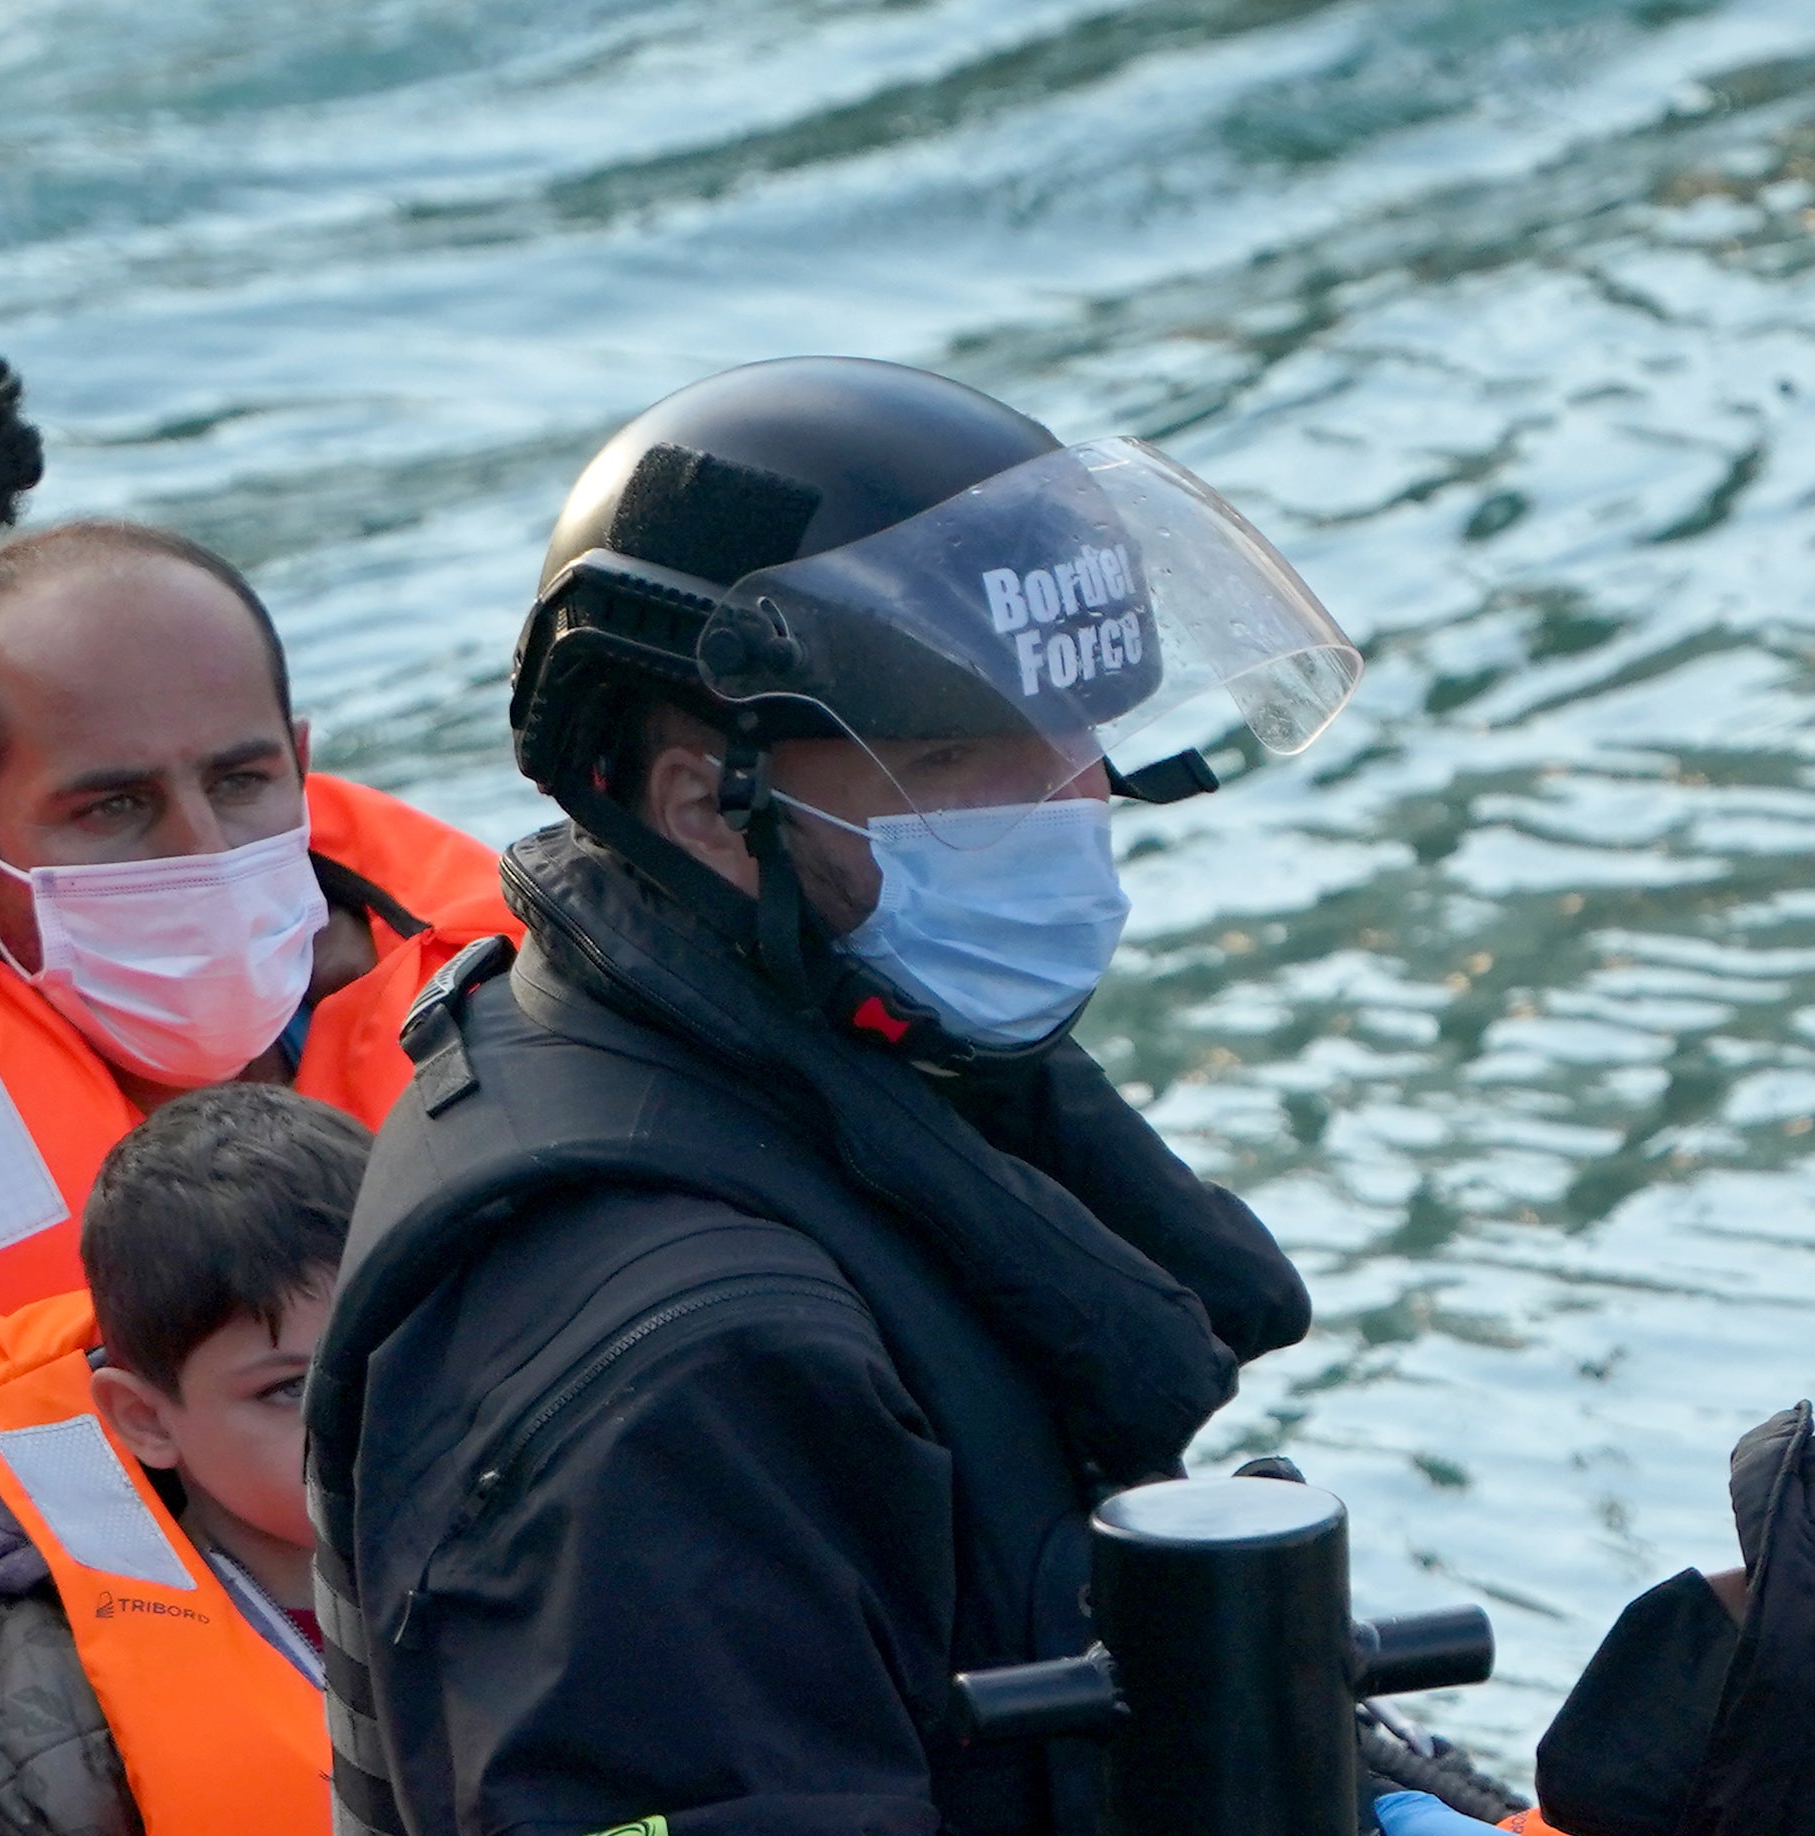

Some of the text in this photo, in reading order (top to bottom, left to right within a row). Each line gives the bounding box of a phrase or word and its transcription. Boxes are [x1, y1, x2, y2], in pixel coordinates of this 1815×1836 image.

[982, 543, 1137, 634] Border
[1015, 611, 1144, 697] Force
[118, 1598, 211, 1624] TRIBORD
